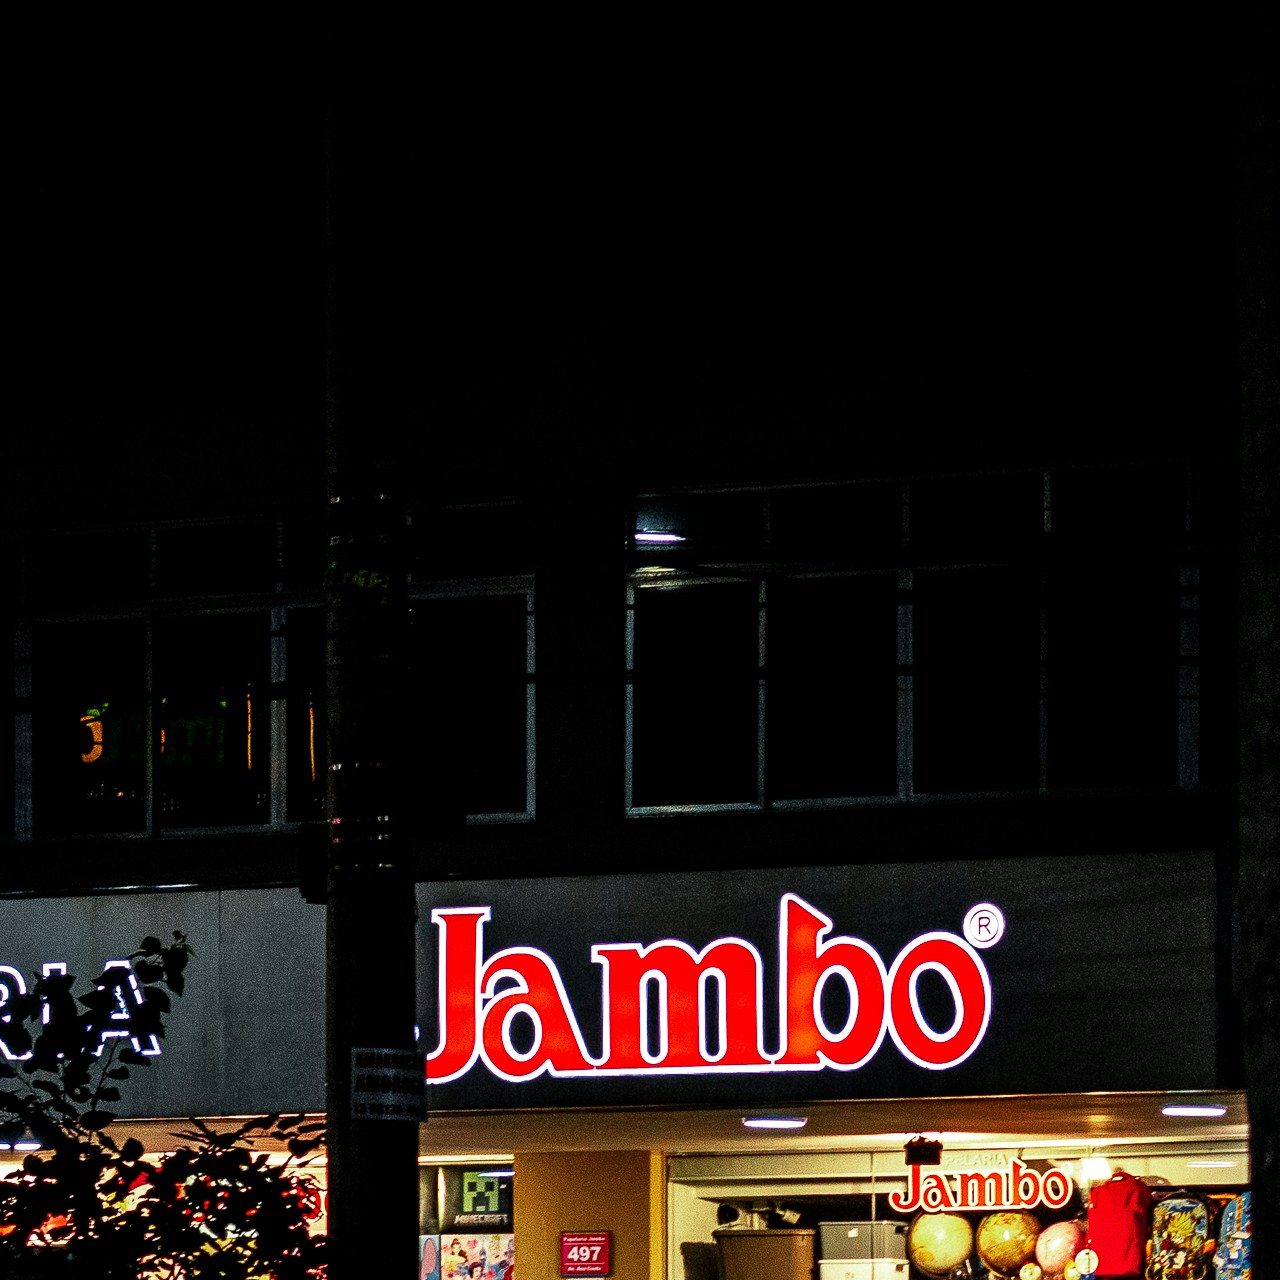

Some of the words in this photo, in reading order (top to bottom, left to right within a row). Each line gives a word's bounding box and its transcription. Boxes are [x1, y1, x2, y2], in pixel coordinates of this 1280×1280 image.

[425, 893, 992, 1084] Jambo
[888, 1156, 1073, 1213] Jambo
[567, 1246, 602, 1262] 497
